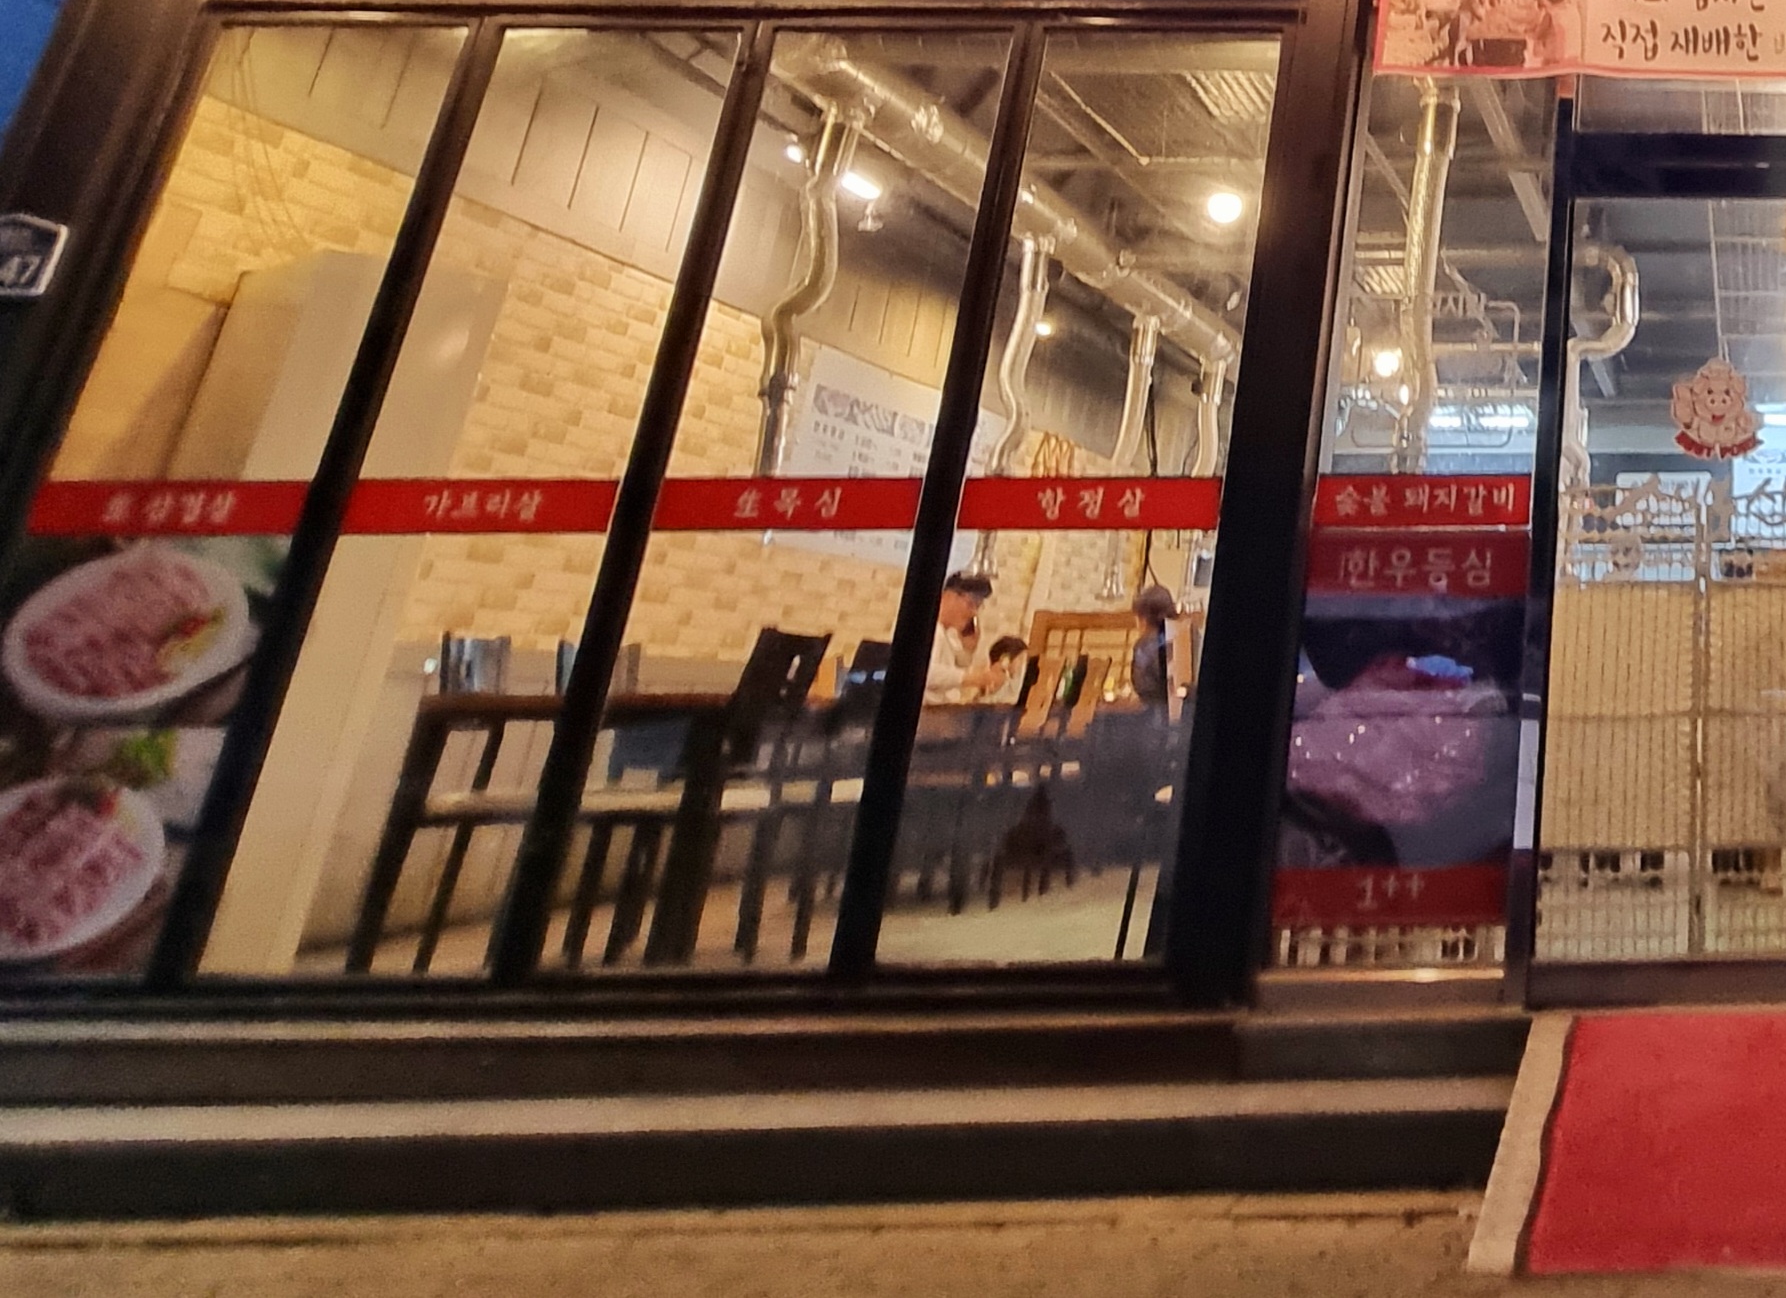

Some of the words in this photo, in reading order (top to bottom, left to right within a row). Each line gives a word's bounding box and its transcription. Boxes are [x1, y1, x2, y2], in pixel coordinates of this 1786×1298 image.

[1601, 18, 1659, 63] 직접
[1670, 23, 1763, 63] 재배한
[1404, 482, 1515, 517] 돼지갈비
